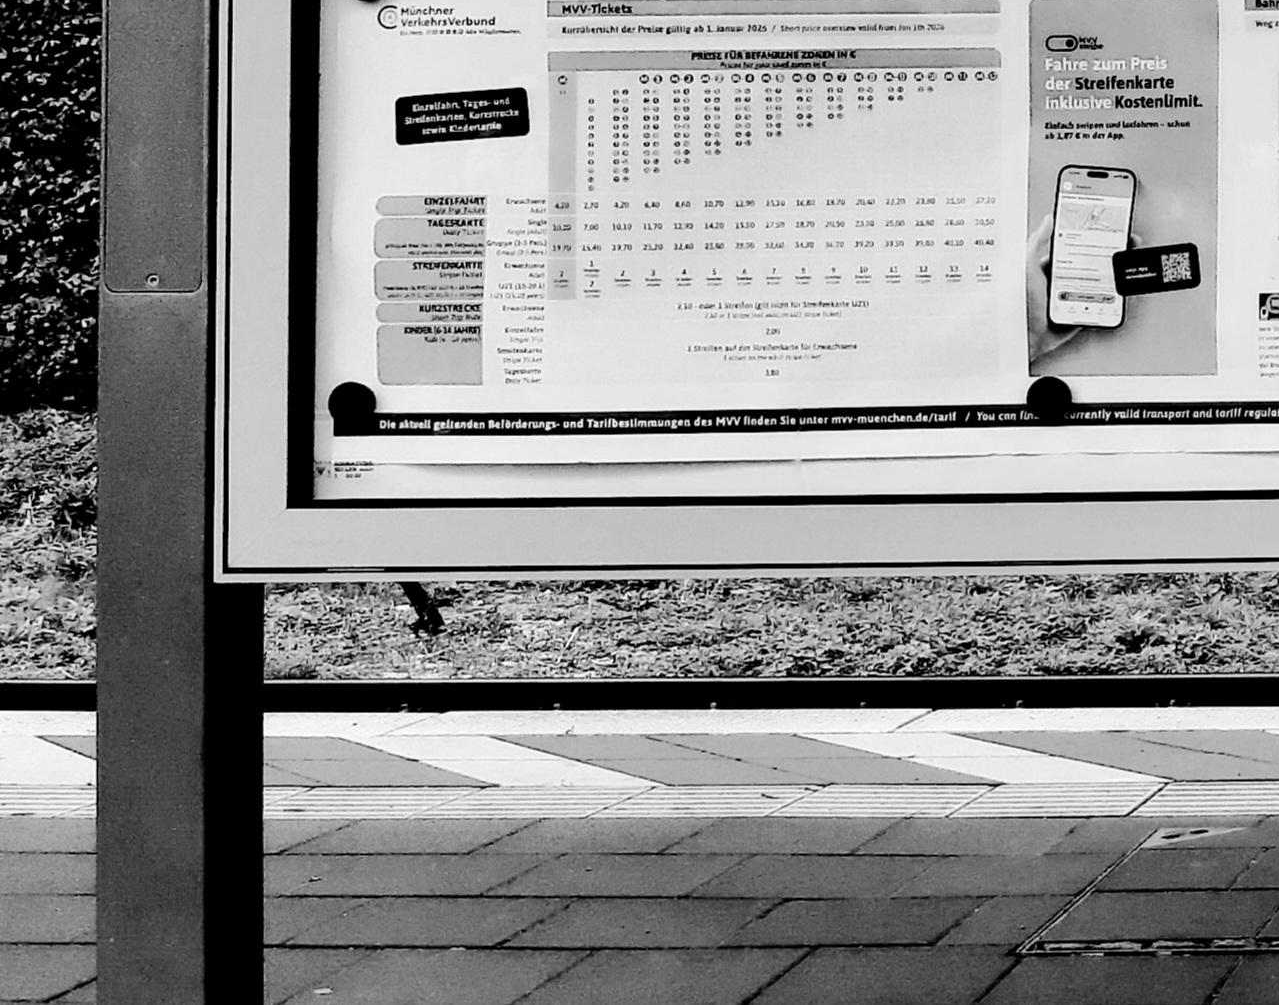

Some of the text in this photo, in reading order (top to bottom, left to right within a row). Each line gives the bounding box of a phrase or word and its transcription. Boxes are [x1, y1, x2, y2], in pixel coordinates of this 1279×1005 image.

[401, 6, 454, 16] Münchner
[562, 3, 632, 14] MVV-Tickets
[401, 17, 496, 27] VerkehrsVerbund
[1045, 56, 1168, 71] Fahre zum Preis
[1045, 75, 1175, 91] der Streifenkarte
[1045, 94, 1203, 110] inklusive Kostenlimit.
[379, 420, 396, 429] Die
[434, 419, 485, 431] geltenden
[488, 418, 560, 431] Beförderungs-
[563, 419, 584, 429] und
[586, 416, 692, 429] Tarifbestimmungen
[694, 416, 713, 427] des
[716, 416, 741, 426] MVV
[743, 415, 777, 426] finden
[780, 415, 796, 425] Sie
[799, 415, 829, 425] unter
[831, 411, 957, 424] mvv-muenchen.de/tarif
[977, 411, 995, 421] You
[998, 412, 1016, 421] can
[1114, 408, 1140, 419] valid
[1142, 408, 1190, 421] transport
[1192, 408, 1213, 419] and
[1215, 407, 1242, 418] tariff
